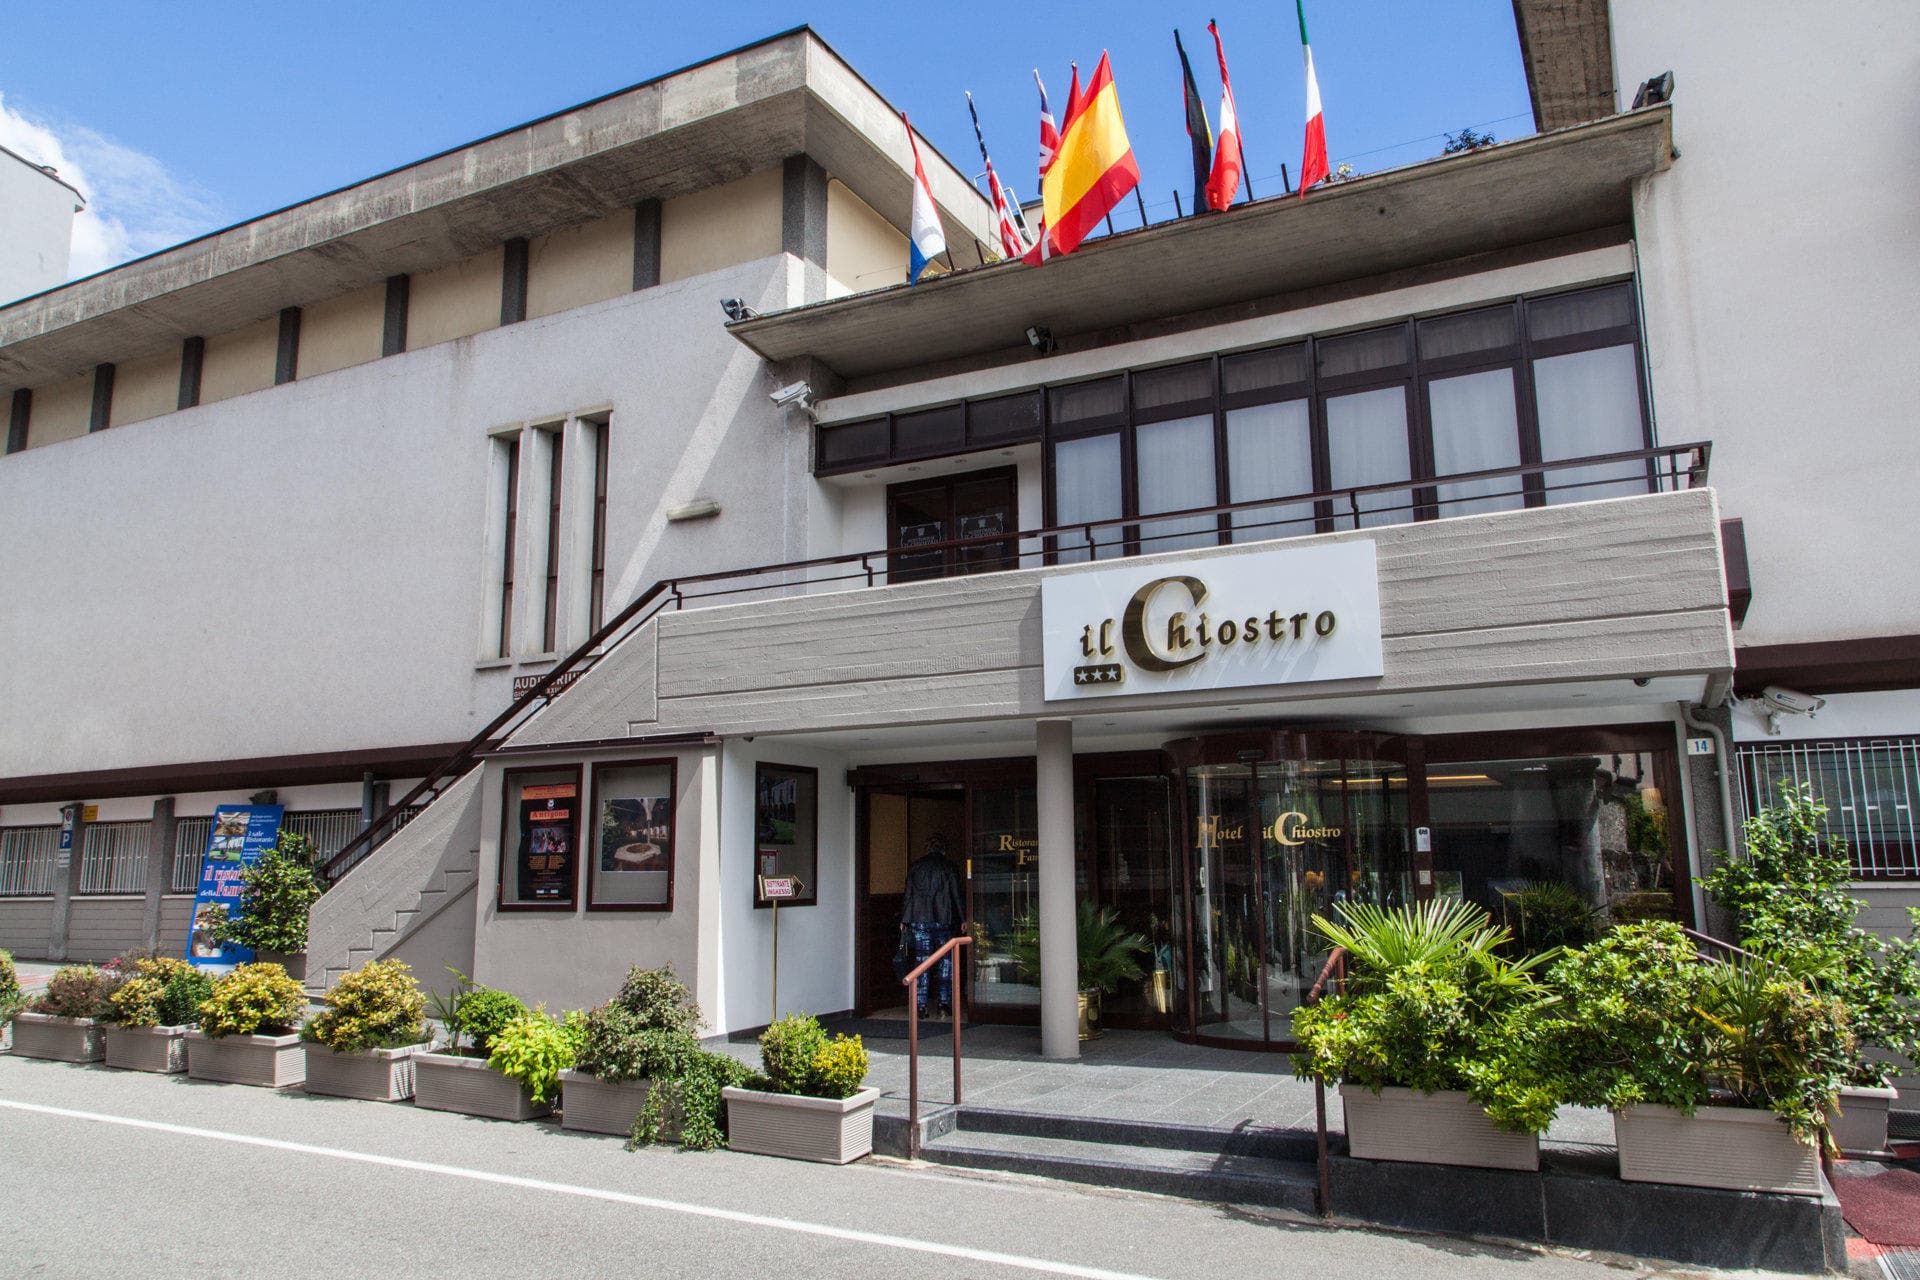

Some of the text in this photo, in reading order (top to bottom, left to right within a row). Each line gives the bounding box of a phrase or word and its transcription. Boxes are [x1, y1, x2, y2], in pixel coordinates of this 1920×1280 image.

[1080, 575, 1336, 672] il Chiostro
[1695, 740, 1708, 752] 14
[1195, 811, 1342, 849] Hotel il Chiostro
[63, 832, 70, 847] P
[998, 834, 1040, 851] Ristoran
[204, 865, 214, 881] il
